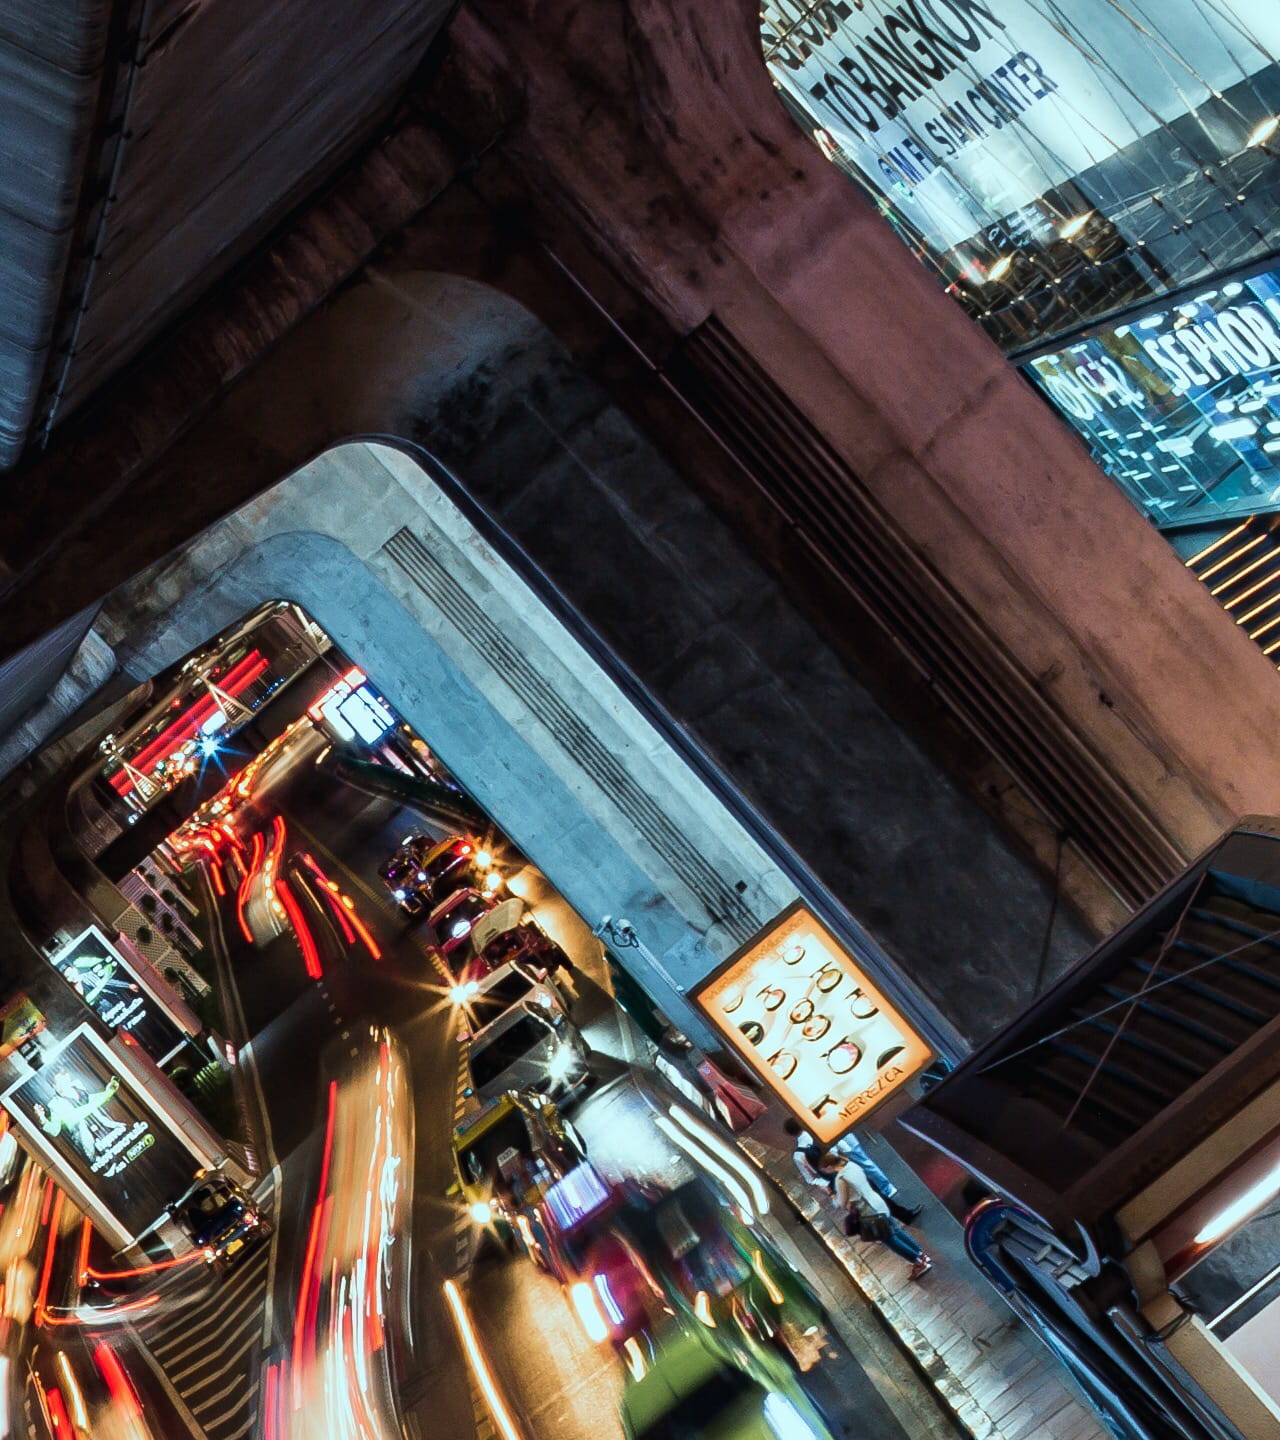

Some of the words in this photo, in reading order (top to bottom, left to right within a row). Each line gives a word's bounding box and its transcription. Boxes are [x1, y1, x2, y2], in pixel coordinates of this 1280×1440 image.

[809, 72, 880, 143] TO
[924, 100, 989, 157] SIAM
[966, 51, 1059, 130] CENTER
[1143, 304, 1280, 397] SEPHOR
